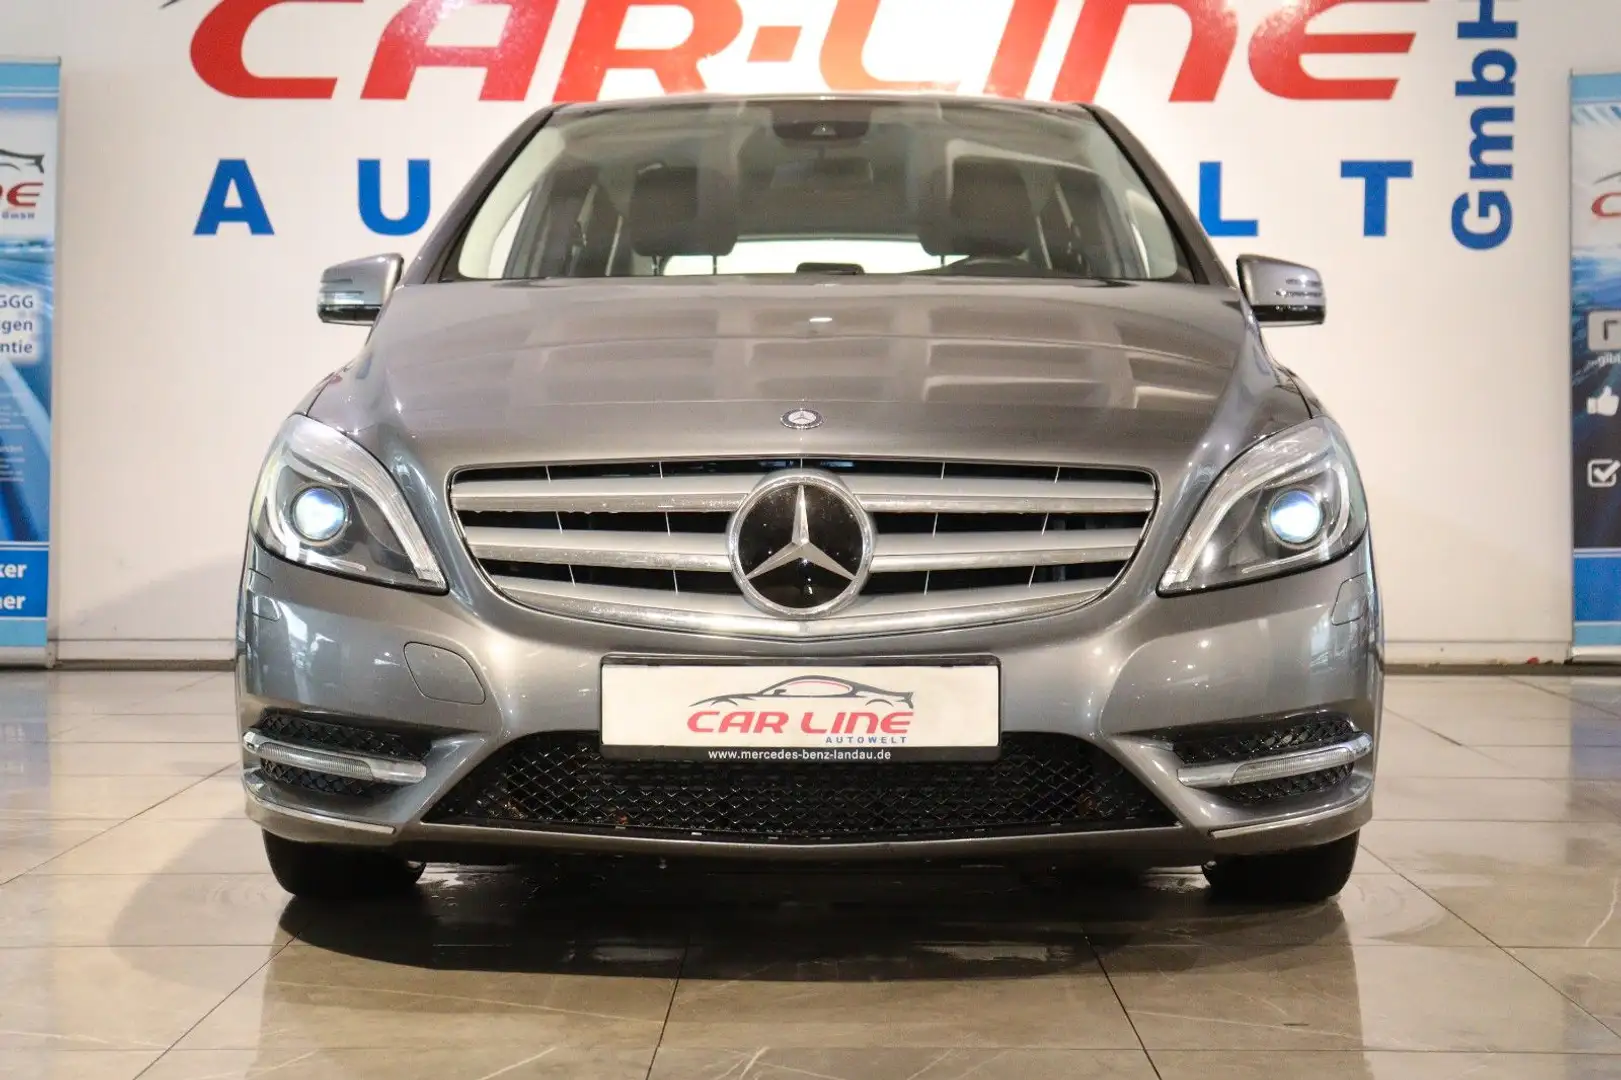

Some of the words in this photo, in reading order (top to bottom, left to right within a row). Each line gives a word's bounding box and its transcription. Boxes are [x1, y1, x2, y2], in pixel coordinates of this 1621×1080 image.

[687, 711, 790, 734] CAR
[800, 711, 914, 735] LINE
[825, 735, 908, 744] AUTOWELT
[707, 748, 892, 761] www.mercedes-benz-landau.de
